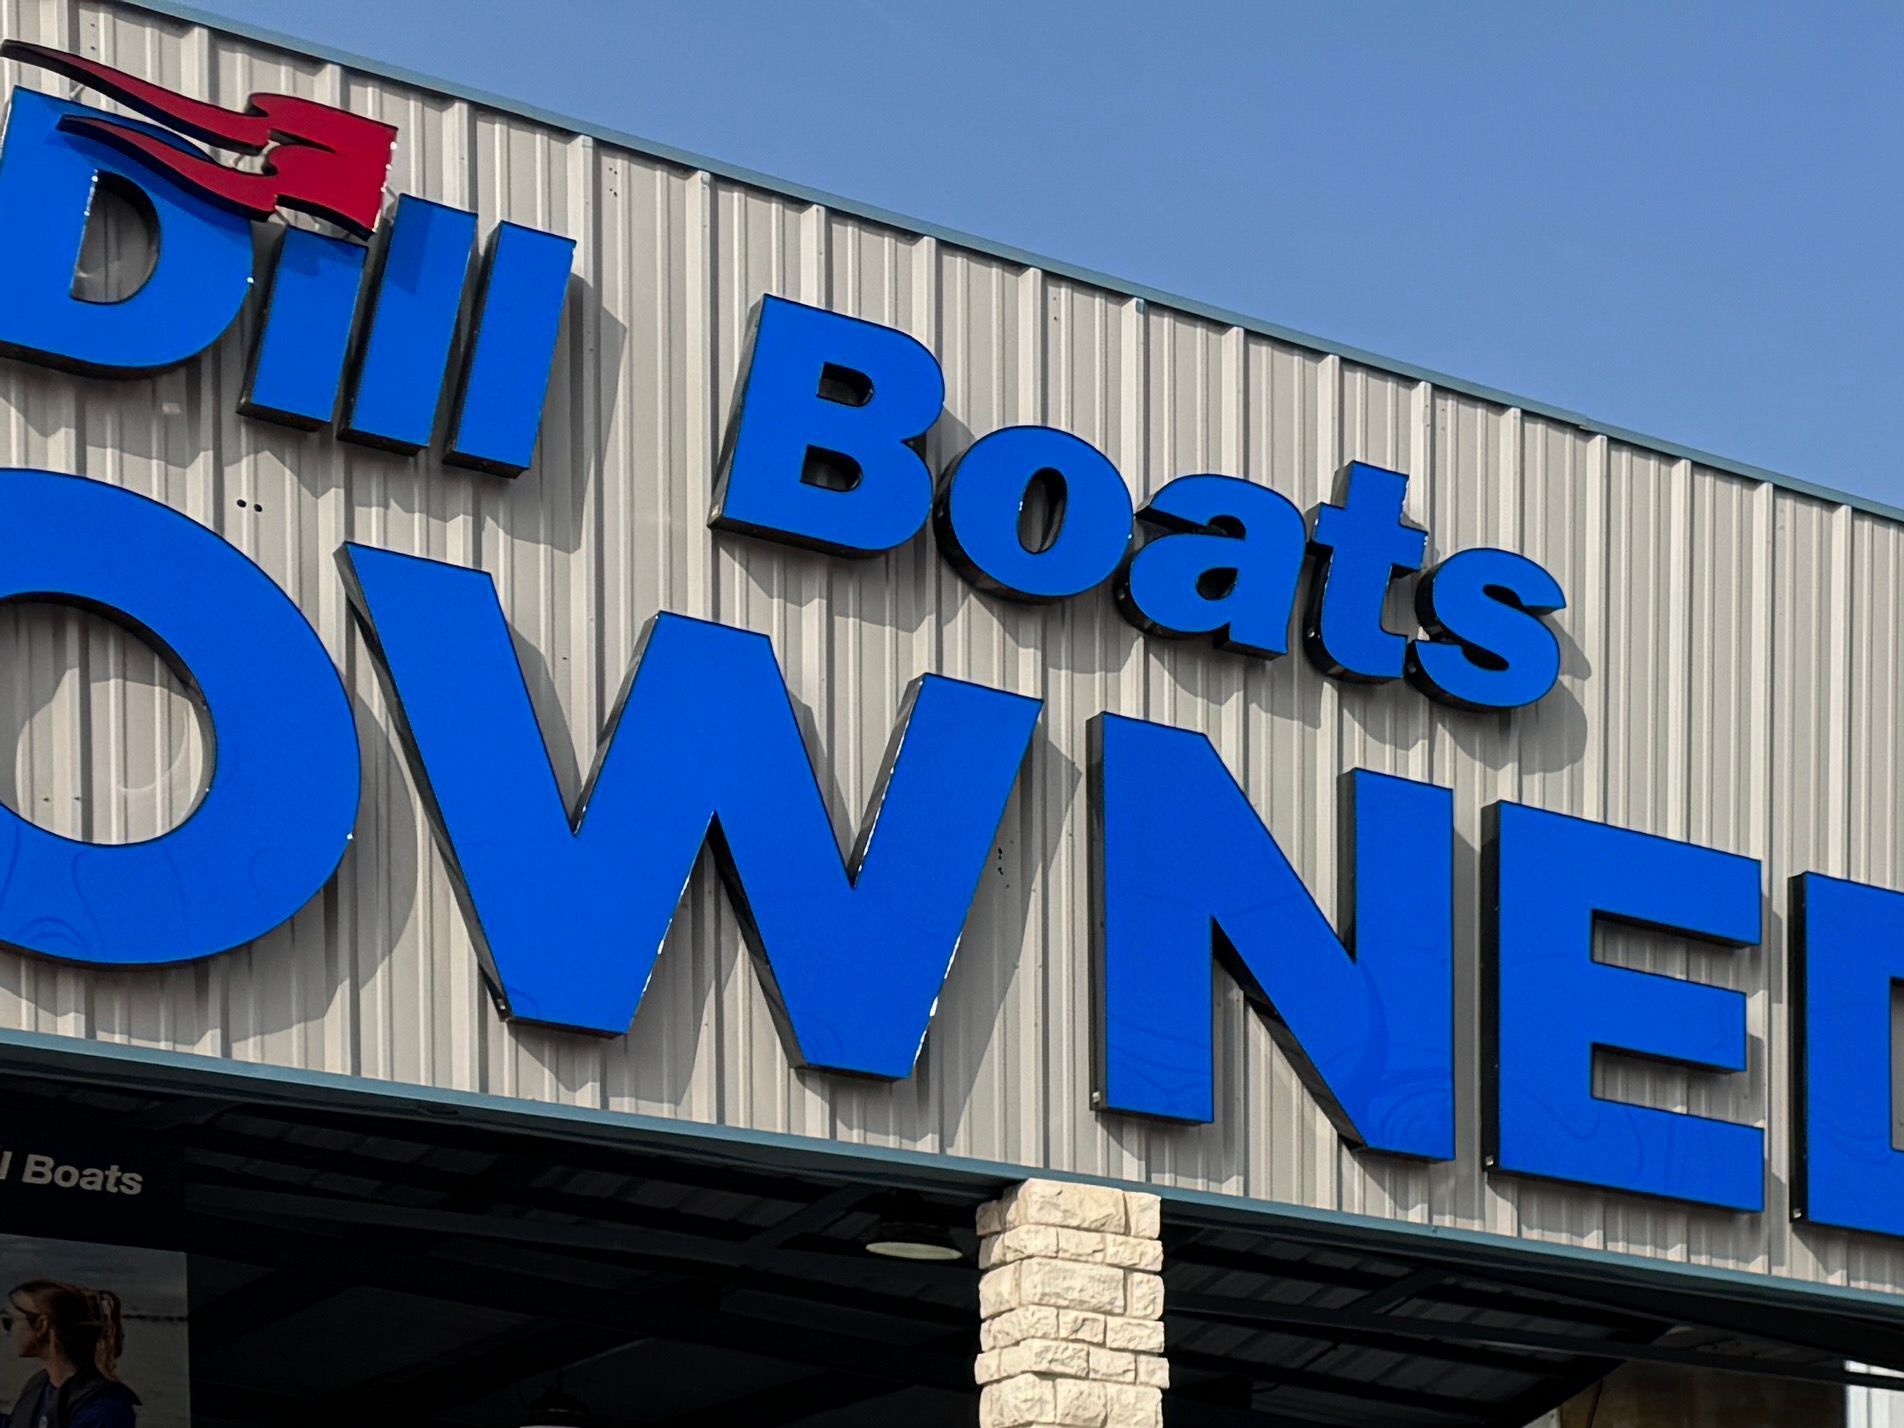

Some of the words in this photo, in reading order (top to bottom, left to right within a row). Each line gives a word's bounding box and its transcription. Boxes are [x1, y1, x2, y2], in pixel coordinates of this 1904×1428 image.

[0, 85, 577, 478] Dill
[711, 292, 1569, 712] Boats
[22, 1153, 144, 1195] Boats
